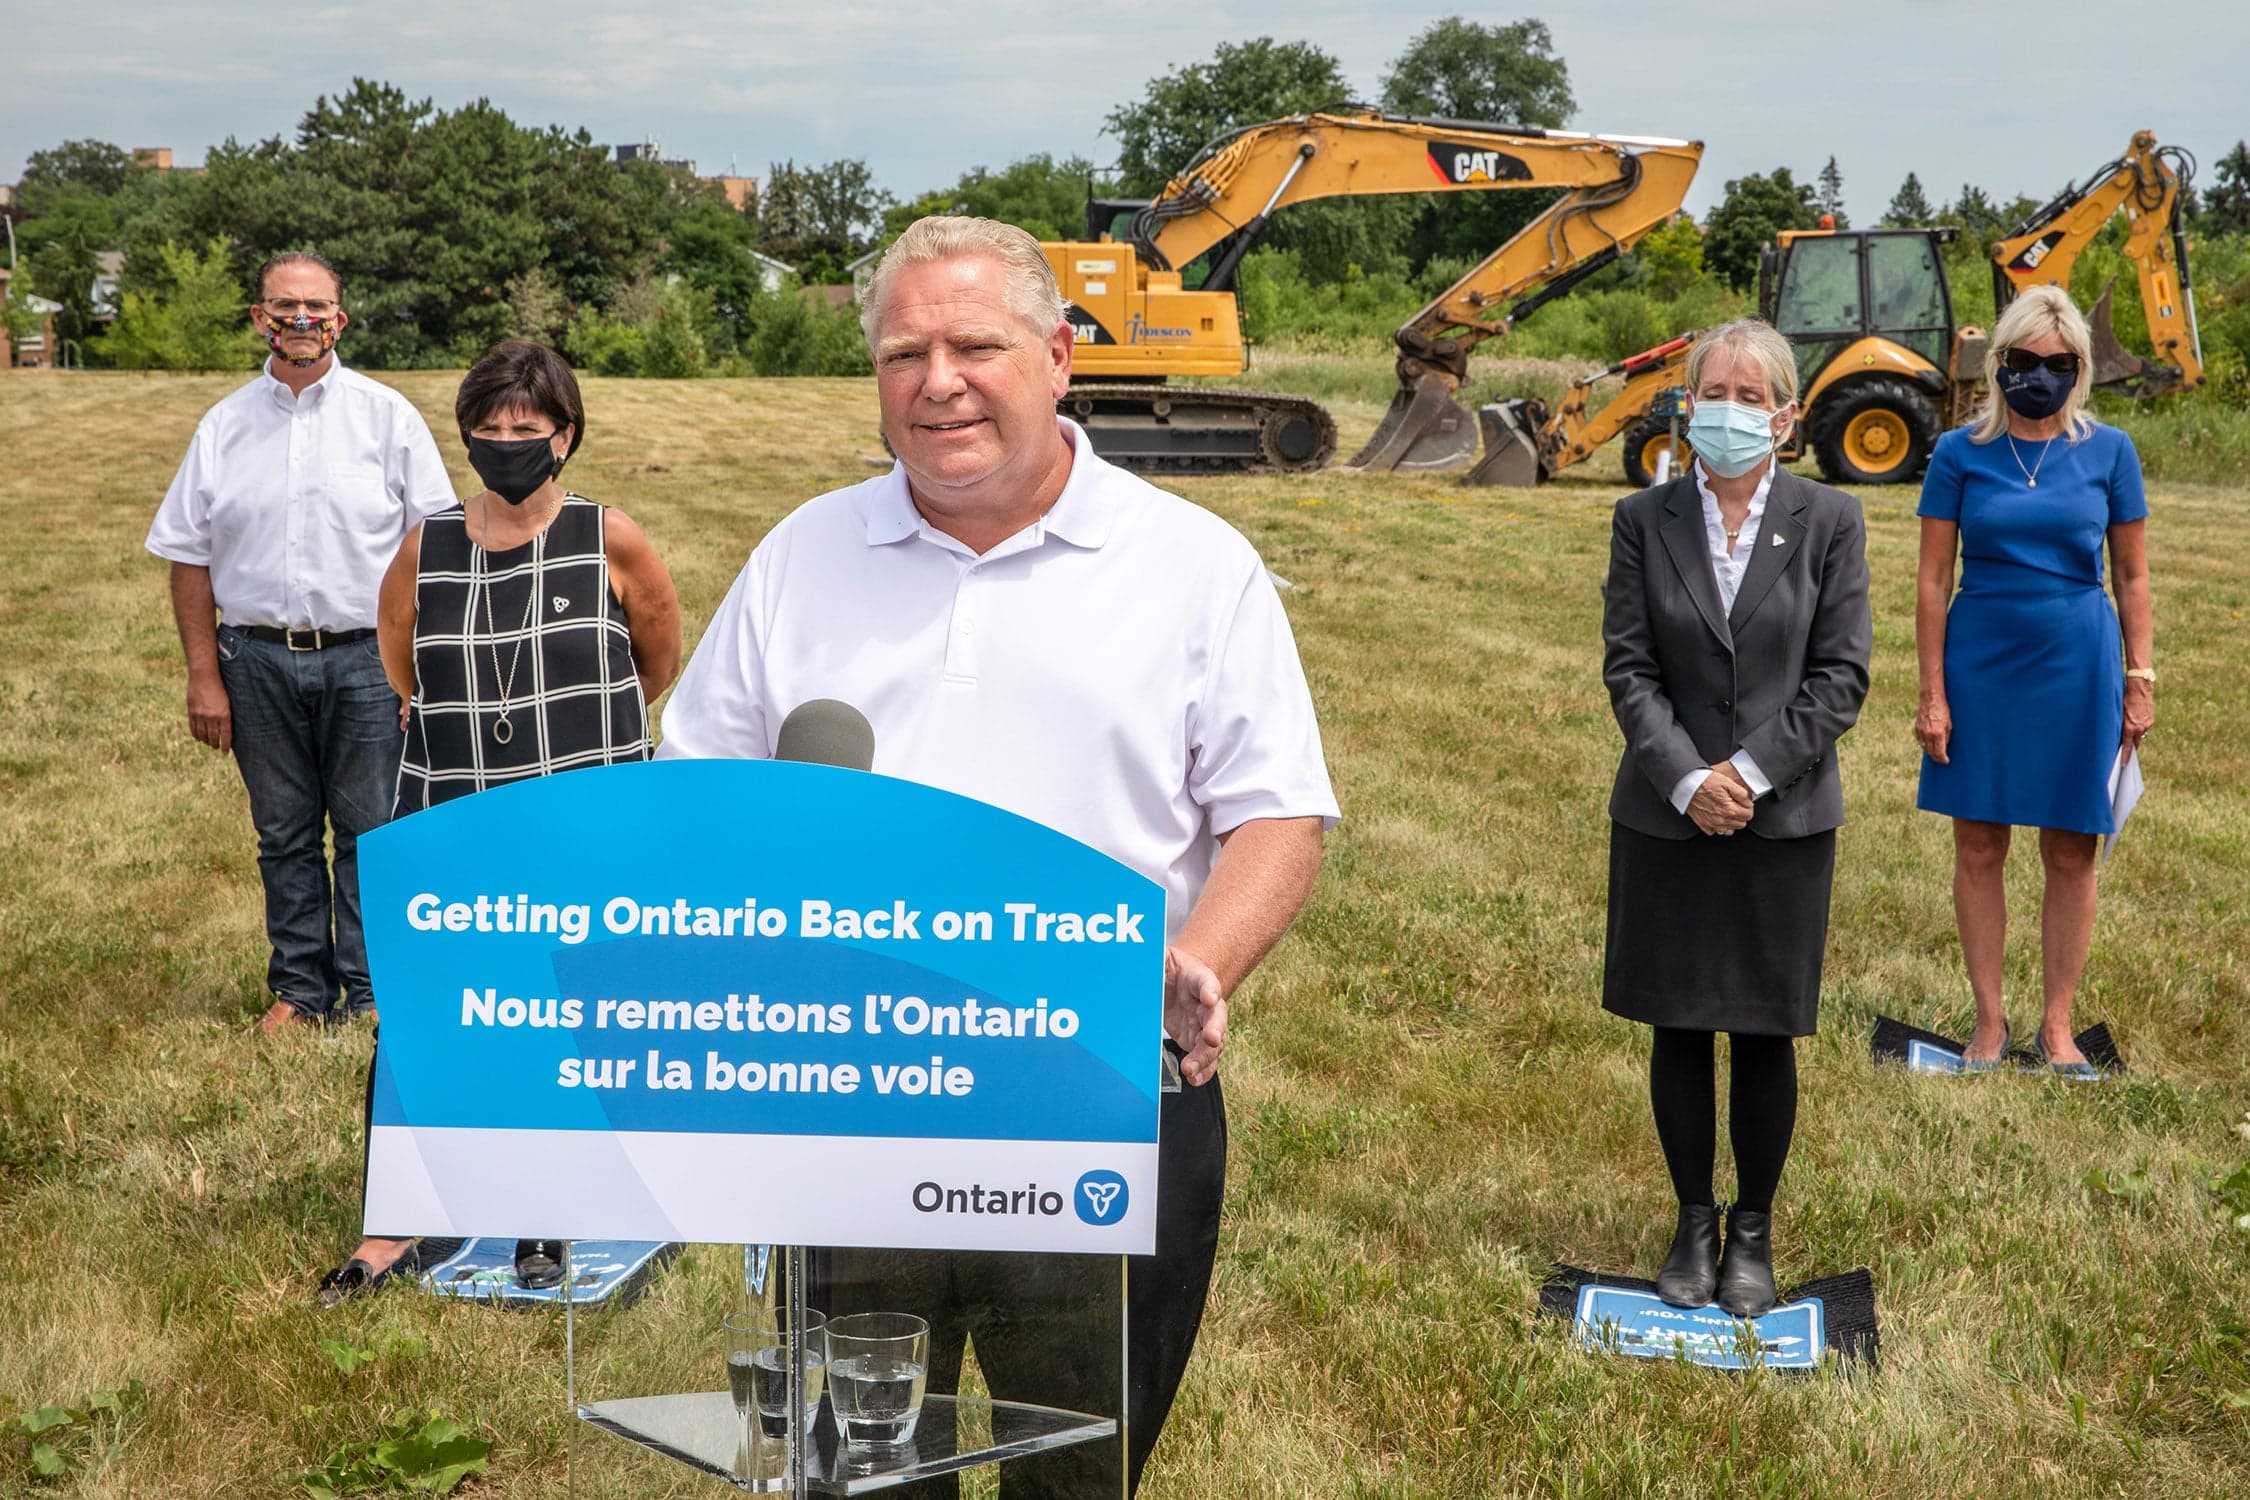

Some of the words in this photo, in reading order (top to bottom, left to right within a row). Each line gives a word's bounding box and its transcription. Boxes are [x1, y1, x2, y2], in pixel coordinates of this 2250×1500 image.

[1453, 151, 1499, 182] CAT
[2023, 238, 2051, 268] CAT
[406, 893, 591, 945] Getting
[603, 896, 788, 938] Ontario
[800, 899, 921, 940] Back
[932, 911, 993, 941] on
[1004, 902, 1145, 943] Track
[461, 988, 584, 1029] Nous
[596, 993, 852, 1035] remettons
[557, 1058, 637, 1089] sur
[646, 1049, 693, 1091] la
[705, 1053, 861, 1095] bonne
[870, 1056, 975, 1097] voie
[912, 1181, 1064, 1217] Ontario
[1692, 1314, 1763, 1330] TANK
